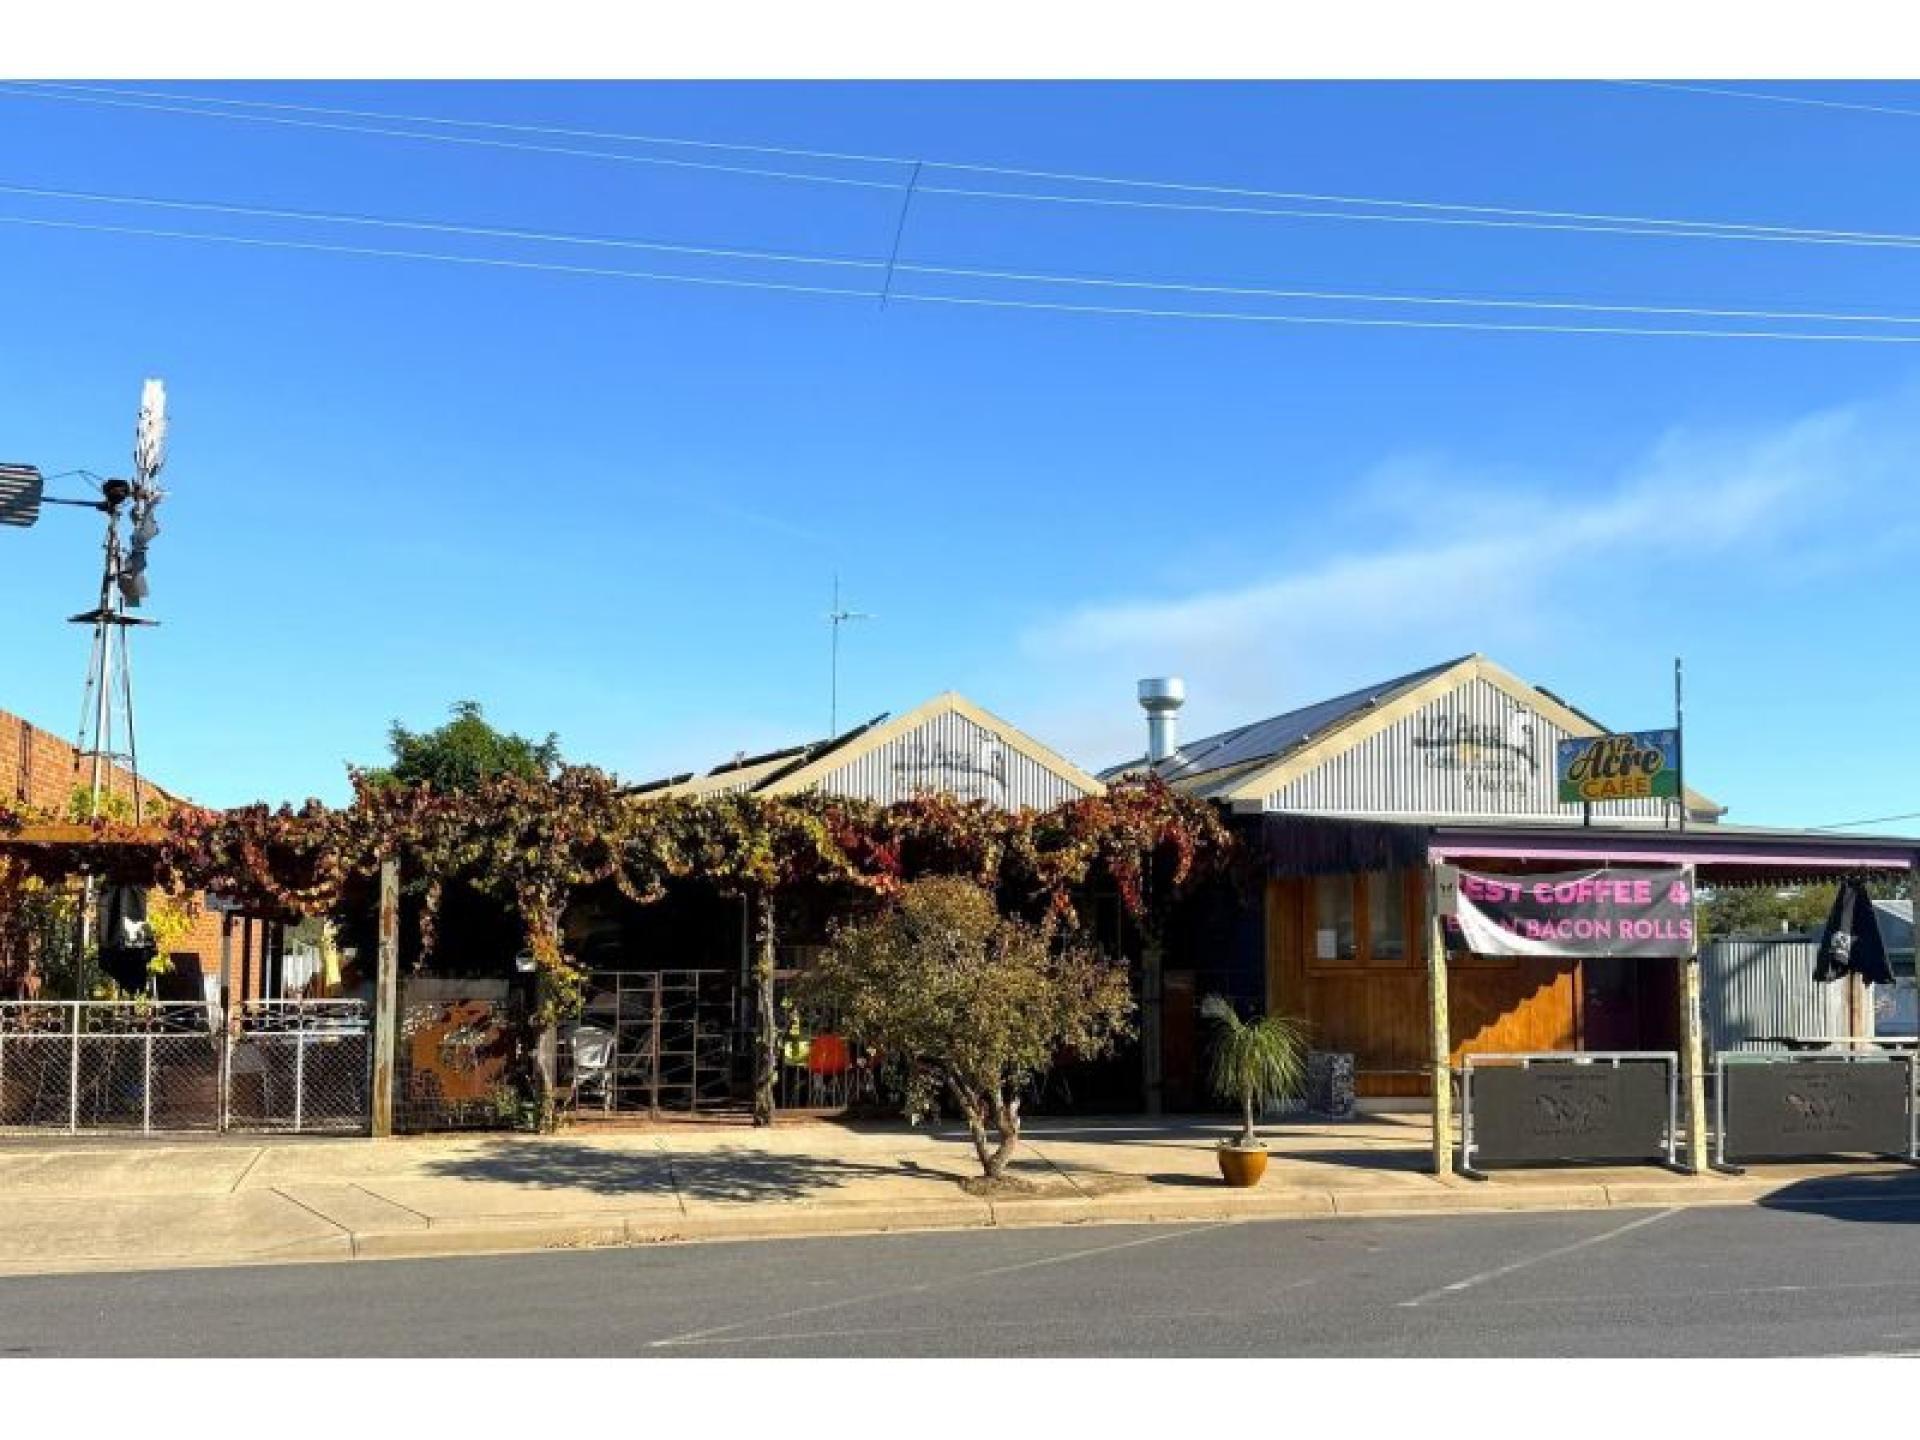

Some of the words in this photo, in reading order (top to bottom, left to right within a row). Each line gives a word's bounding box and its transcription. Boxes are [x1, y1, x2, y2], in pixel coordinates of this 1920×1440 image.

[1567, 738, 1664, 781] Acre
[1582, 777, 1650, 798] CAFE
[1534, 880, 1653, 905] COFFEE
[1525, 918, 1611, 941] BACON
[1619, 919, 1693, 941] ROLLS
